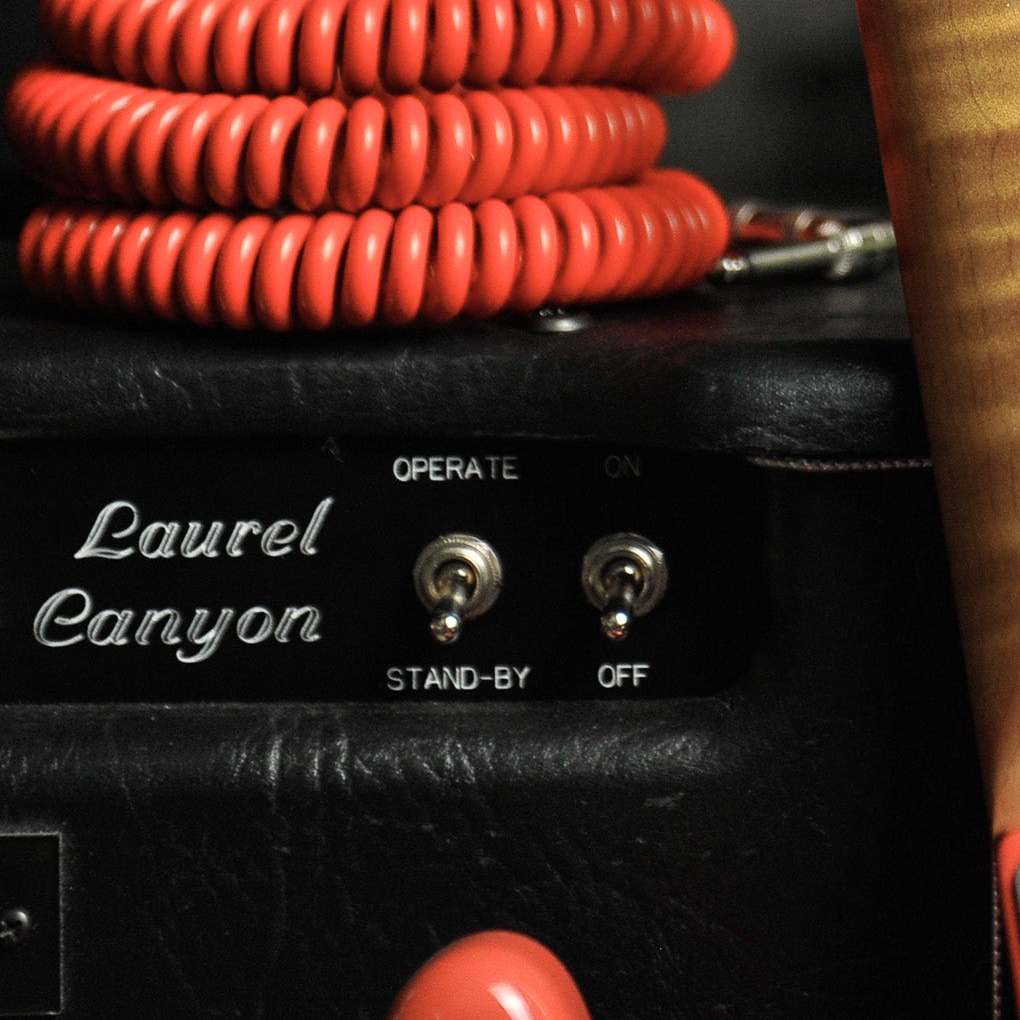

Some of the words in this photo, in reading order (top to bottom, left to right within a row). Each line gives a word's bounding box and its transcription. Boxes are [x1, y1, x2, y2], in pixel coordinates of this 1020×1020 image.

[392, 454, 520, 483] OPERATE
[604, 453, 641, 478] ON
[72, 496, 335, 560] Laurel
[32, 586, 322, 664] Canyon
[386, 664, 532, 692] STAND-BY
[597, 662, 651, 689] OFF
